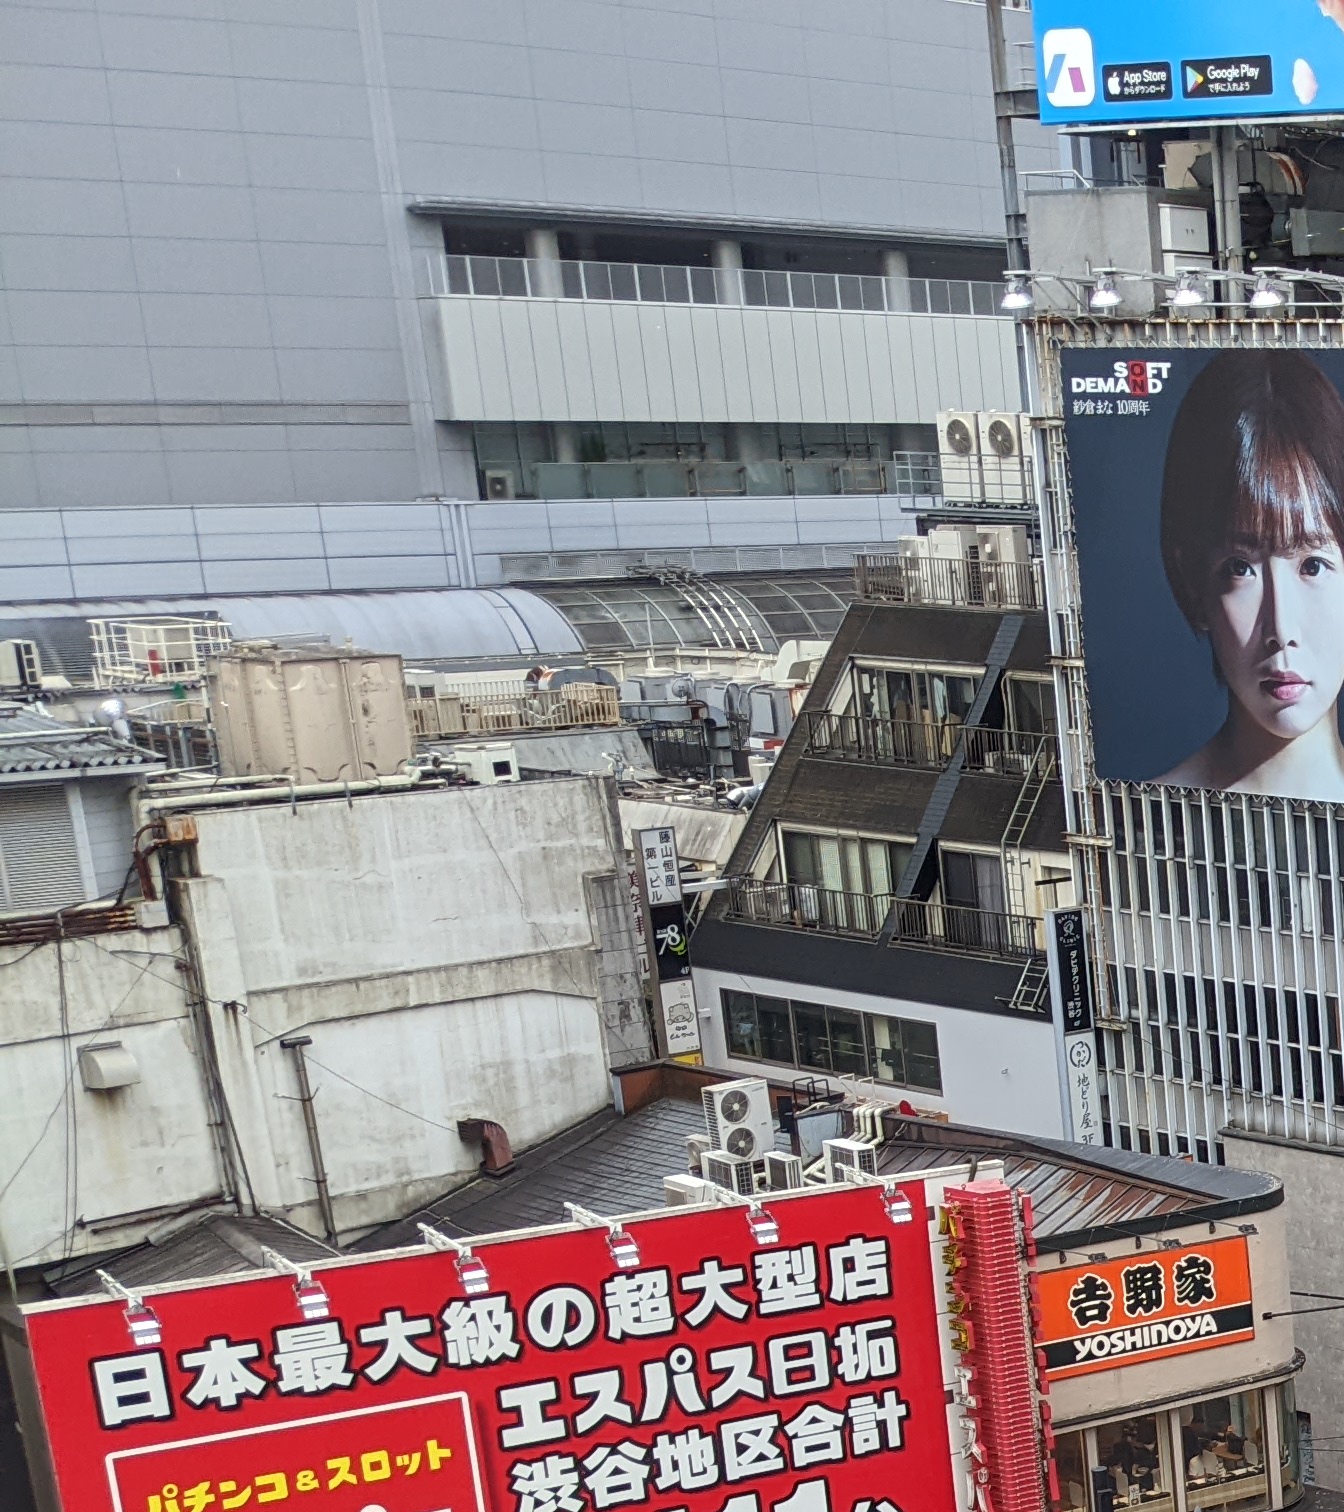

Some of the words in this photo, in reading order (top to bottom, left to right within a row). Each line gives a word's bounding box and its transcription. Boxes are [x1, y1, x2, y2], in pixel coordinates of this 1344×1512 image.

[1123, 70, 1142, 84] App
[1143, 69, 1167, 82] Store
[1206, 64, 1239, 83] Google
[1239, 62, 1260, 80] Play
[1071, 377, 1163, 394] DEMAND
[1113, 361, 1172, 379] SOFT
[1077, 1072, 1093, 1130] 地どり屋
[1081, 1132, 1095, 1145] 3F
[1067, 1252, 1217, 1330] 吉野家
[93, 1235, 892, 1428] 日本最大級の超大型店
[1073, 1312, 1219, 1364] YOSHINOYA
[496, 1316, 900, 1451] エスパス日拓
